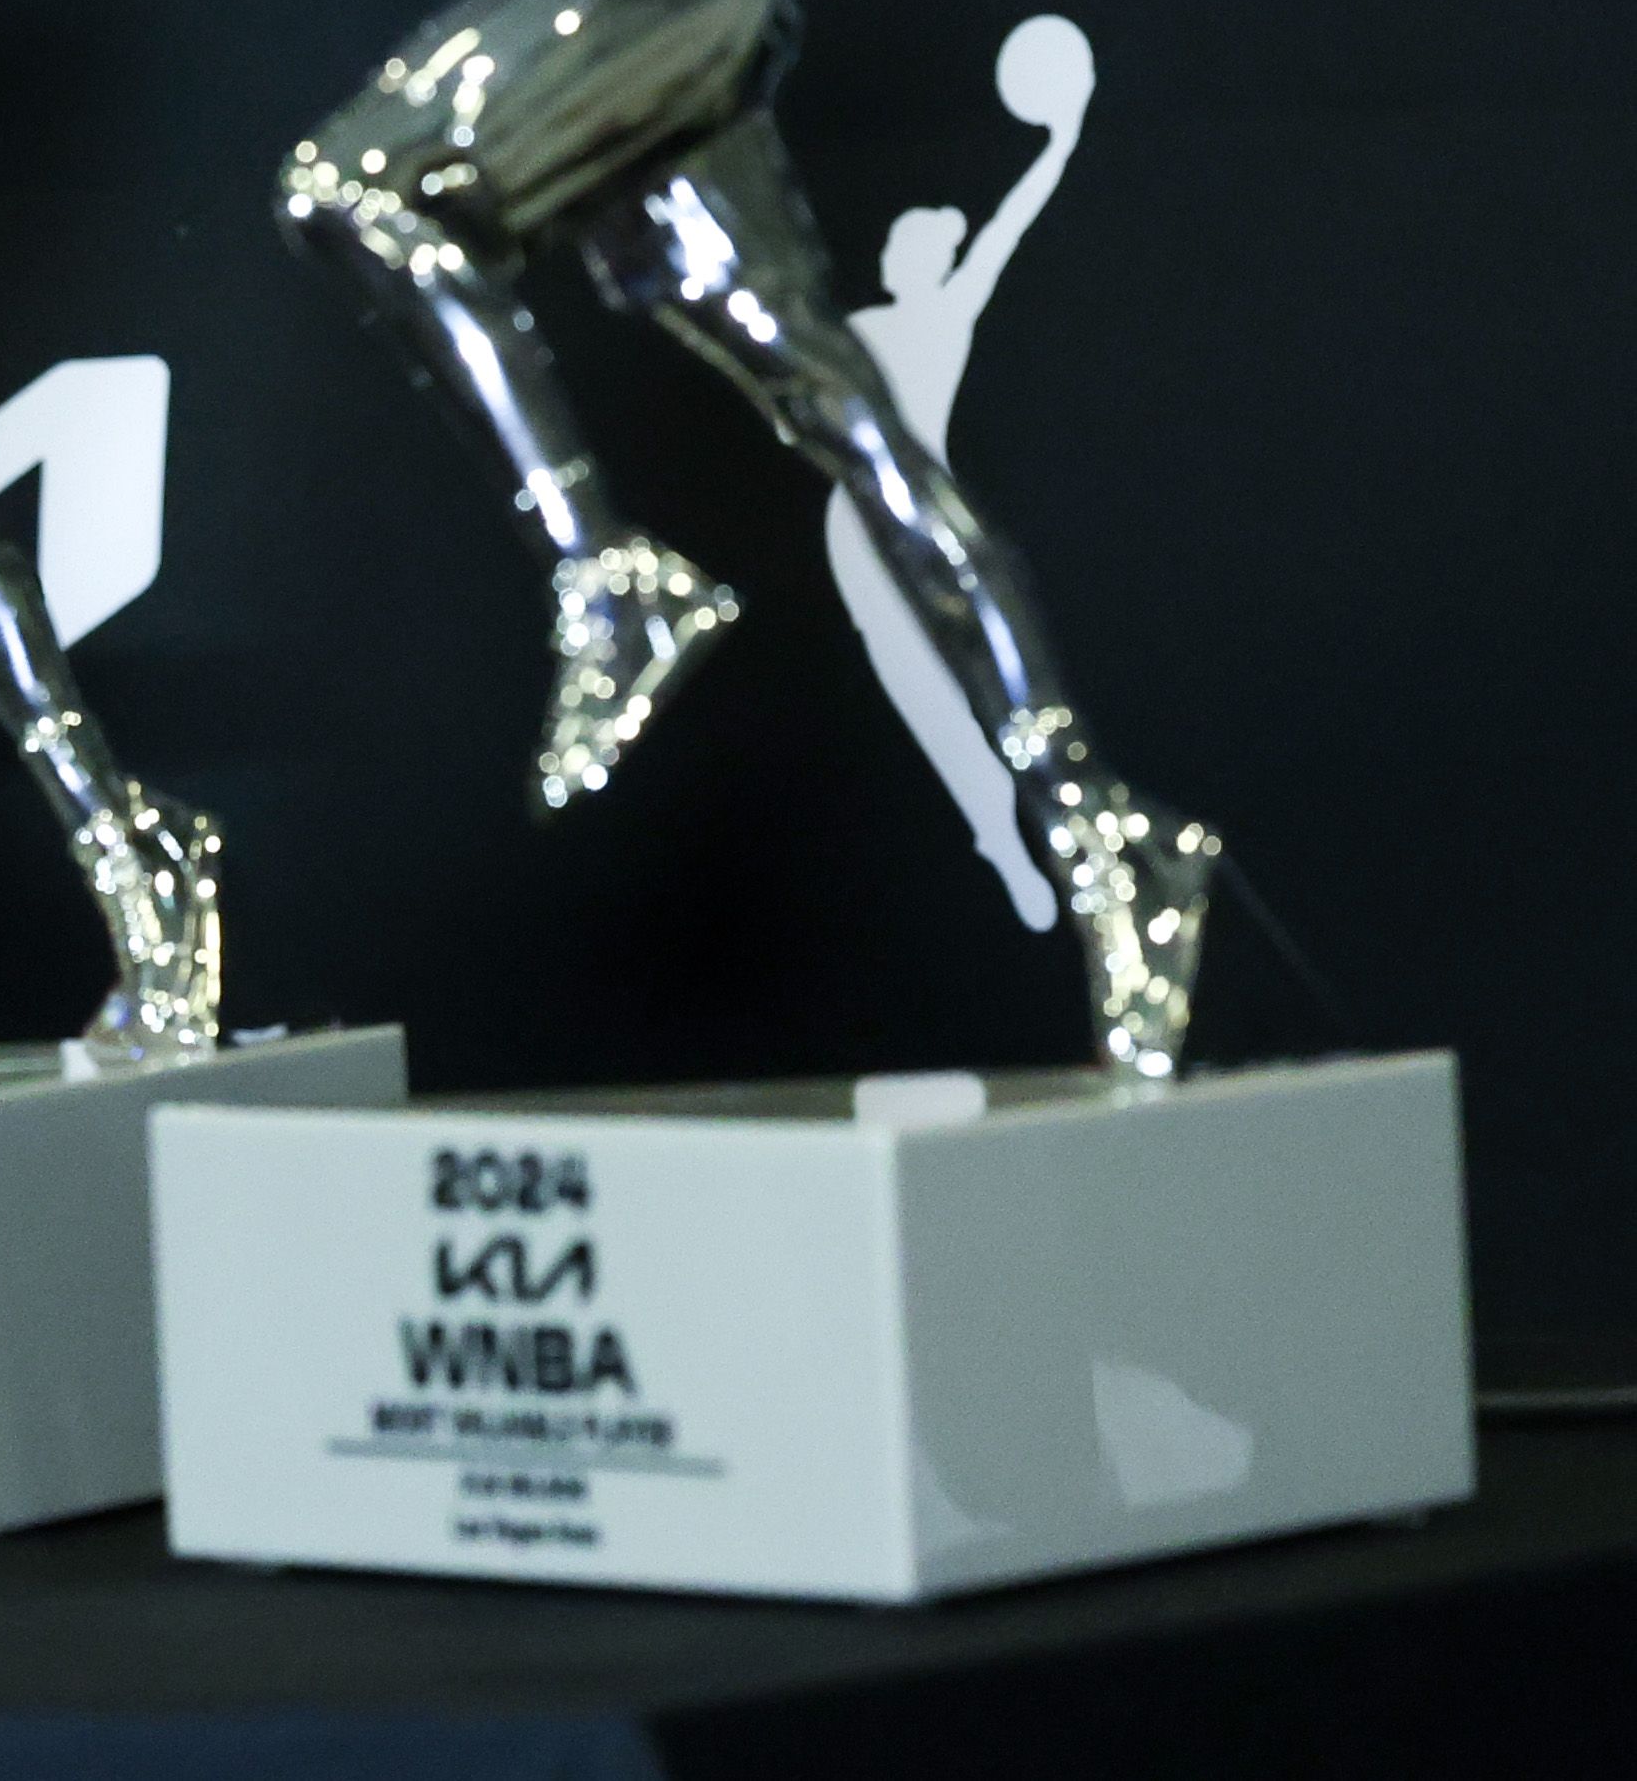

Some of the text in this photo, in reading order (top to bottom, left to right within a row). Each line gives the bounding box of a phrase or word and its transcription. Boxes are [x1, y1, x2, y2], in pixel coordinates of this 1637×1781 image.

[430, 1147, 593, 1215] 2024
[432, 1233, 597, 1305] KIA
[398, 1319, 637, 1395] WNBA
